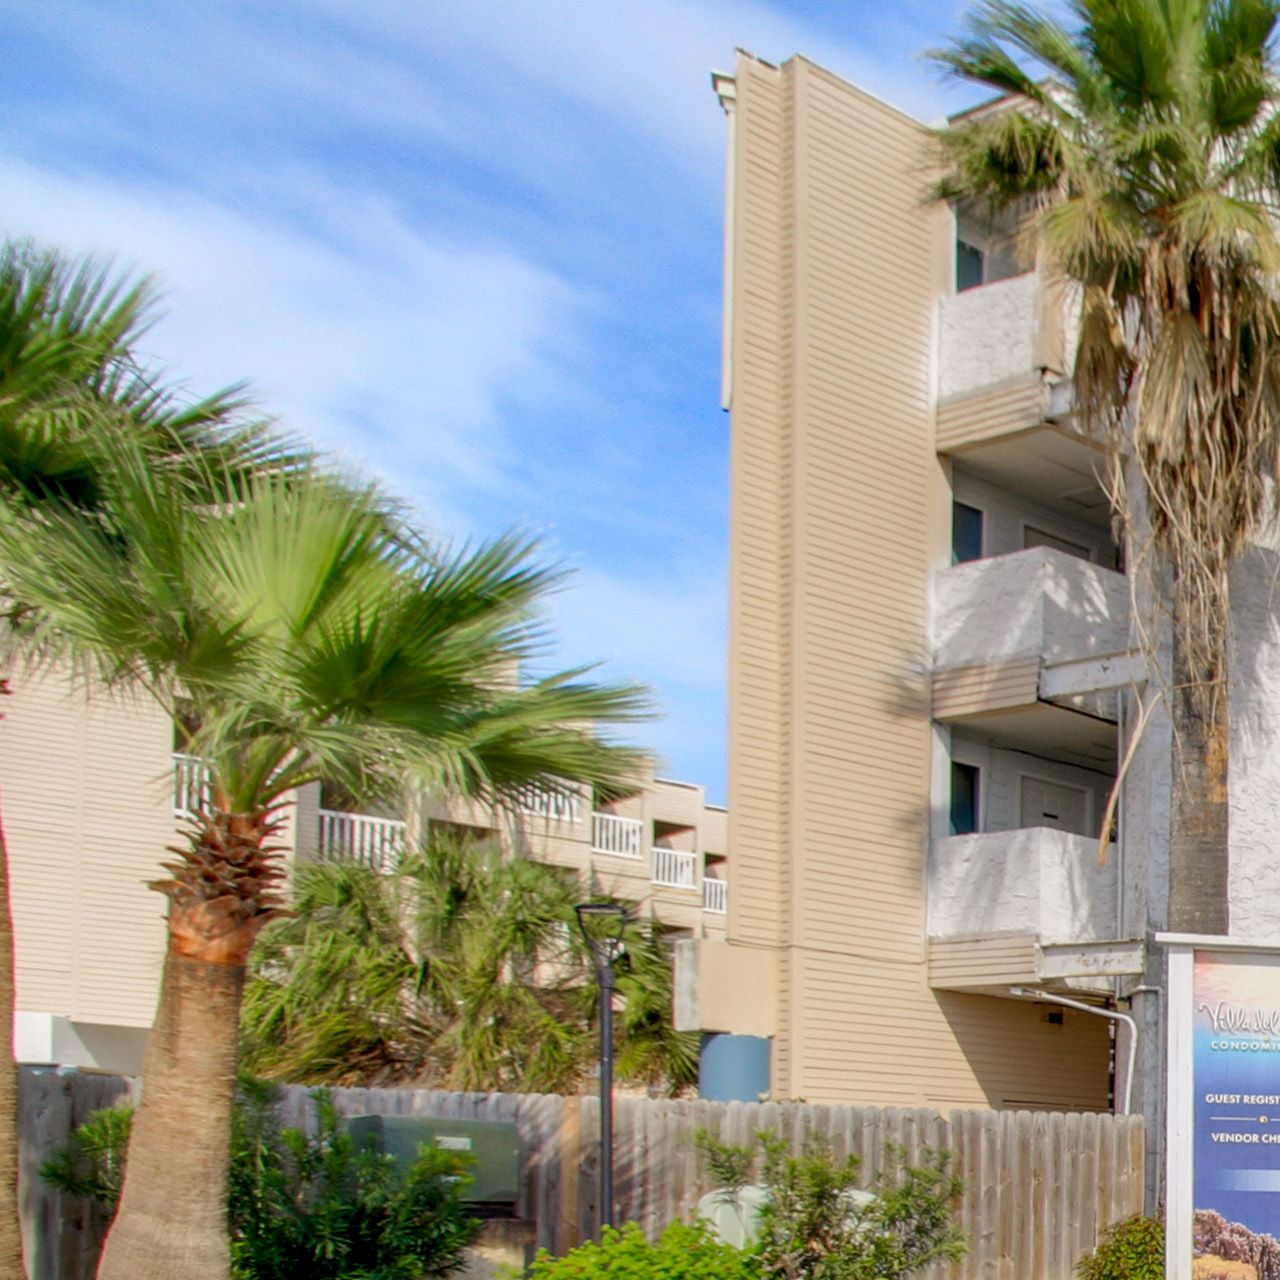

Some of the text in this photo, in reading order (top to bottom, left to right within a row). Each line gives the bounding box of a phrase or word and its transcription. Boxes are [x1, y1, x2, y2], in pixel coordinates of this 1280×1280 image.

[1198, 1001, 1250, 1035] Villa
[1254, 1008, 1279, 1036] del
[1205, 1093, 1241, 1104] GUEST
[1211, 1132, 1259, 1143] VENDOR
